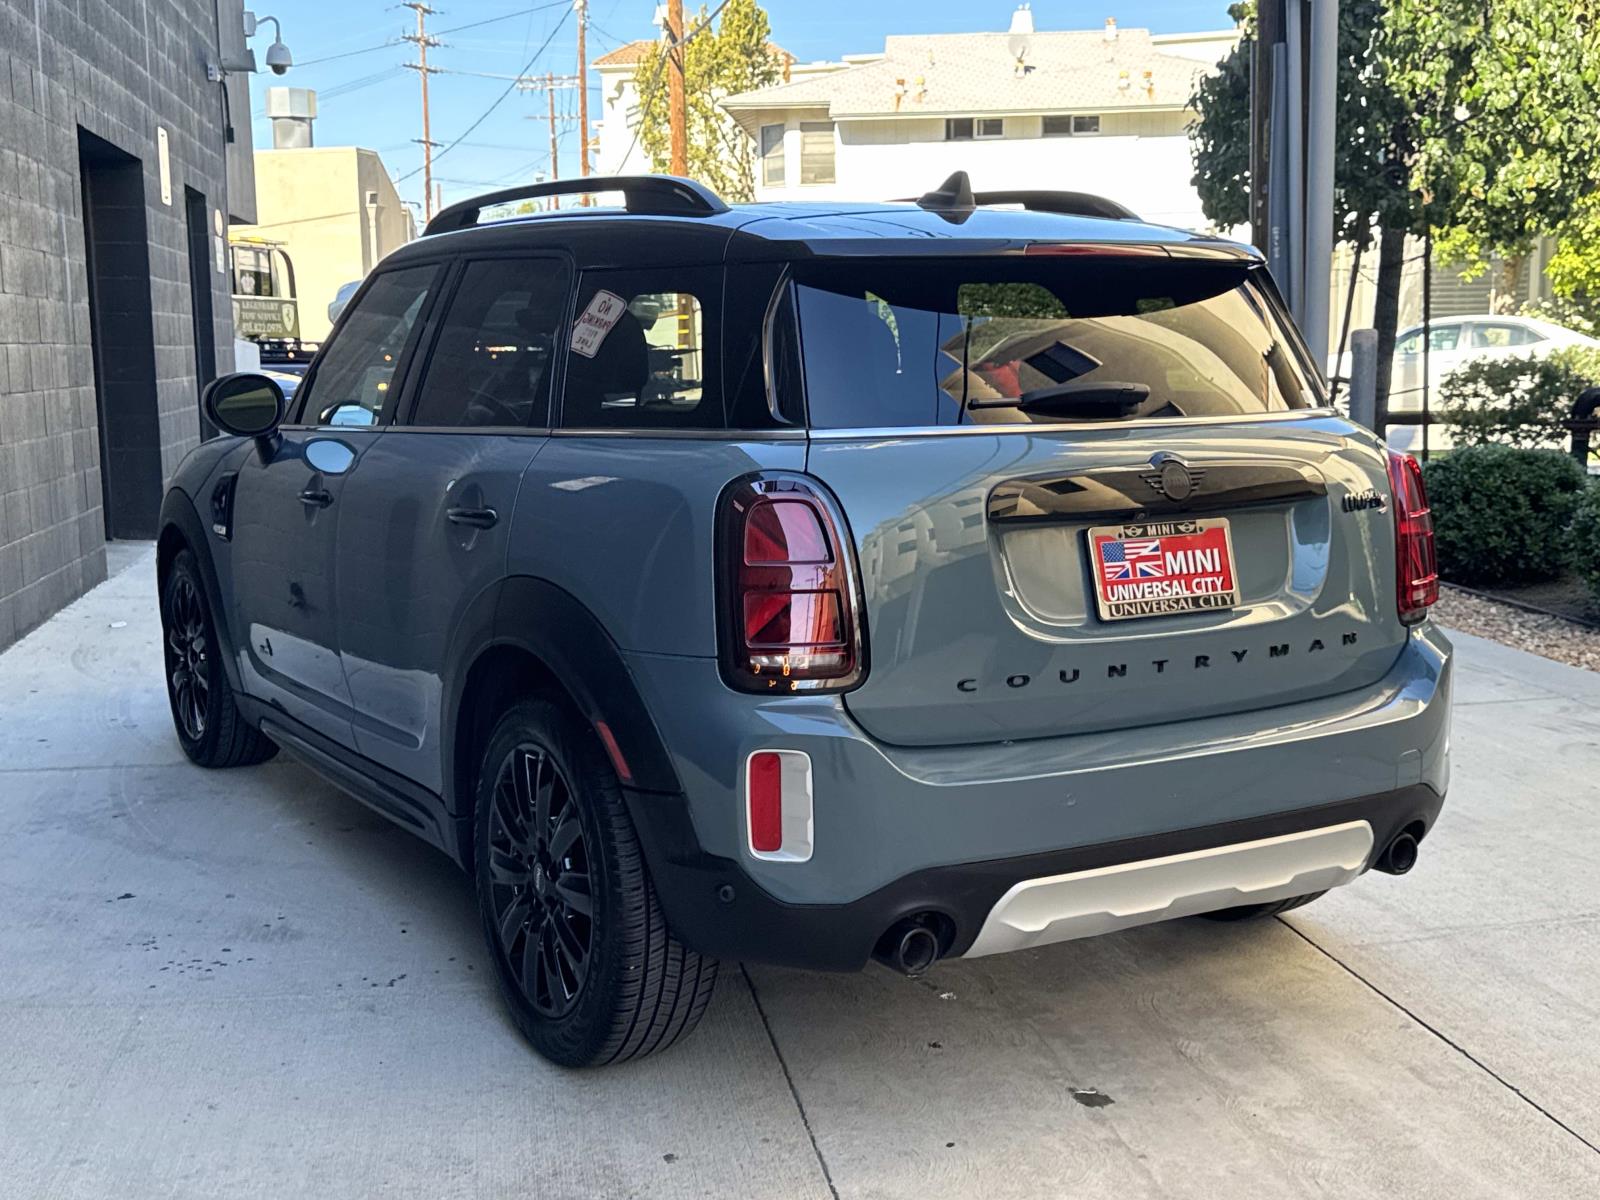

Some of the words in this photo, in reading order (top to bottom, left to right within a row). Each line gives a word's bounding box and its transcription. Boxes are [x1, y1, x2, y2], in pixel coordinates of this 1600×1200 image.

[241, 311, 256, 320] TOW
[1146, 524, 1175, 537] MINI
[1165, 547, 1222, 576] MINI
[1106, 580, 1190, 601] UNIVERSAL
[1192, 576, 1224, 593] CITY
[1111, 598, 1195, 617] UNIVERSAL
[1199, 594, 1232, 608] CITY
[957, 632, 1358, 693] COUNTRYMAN
